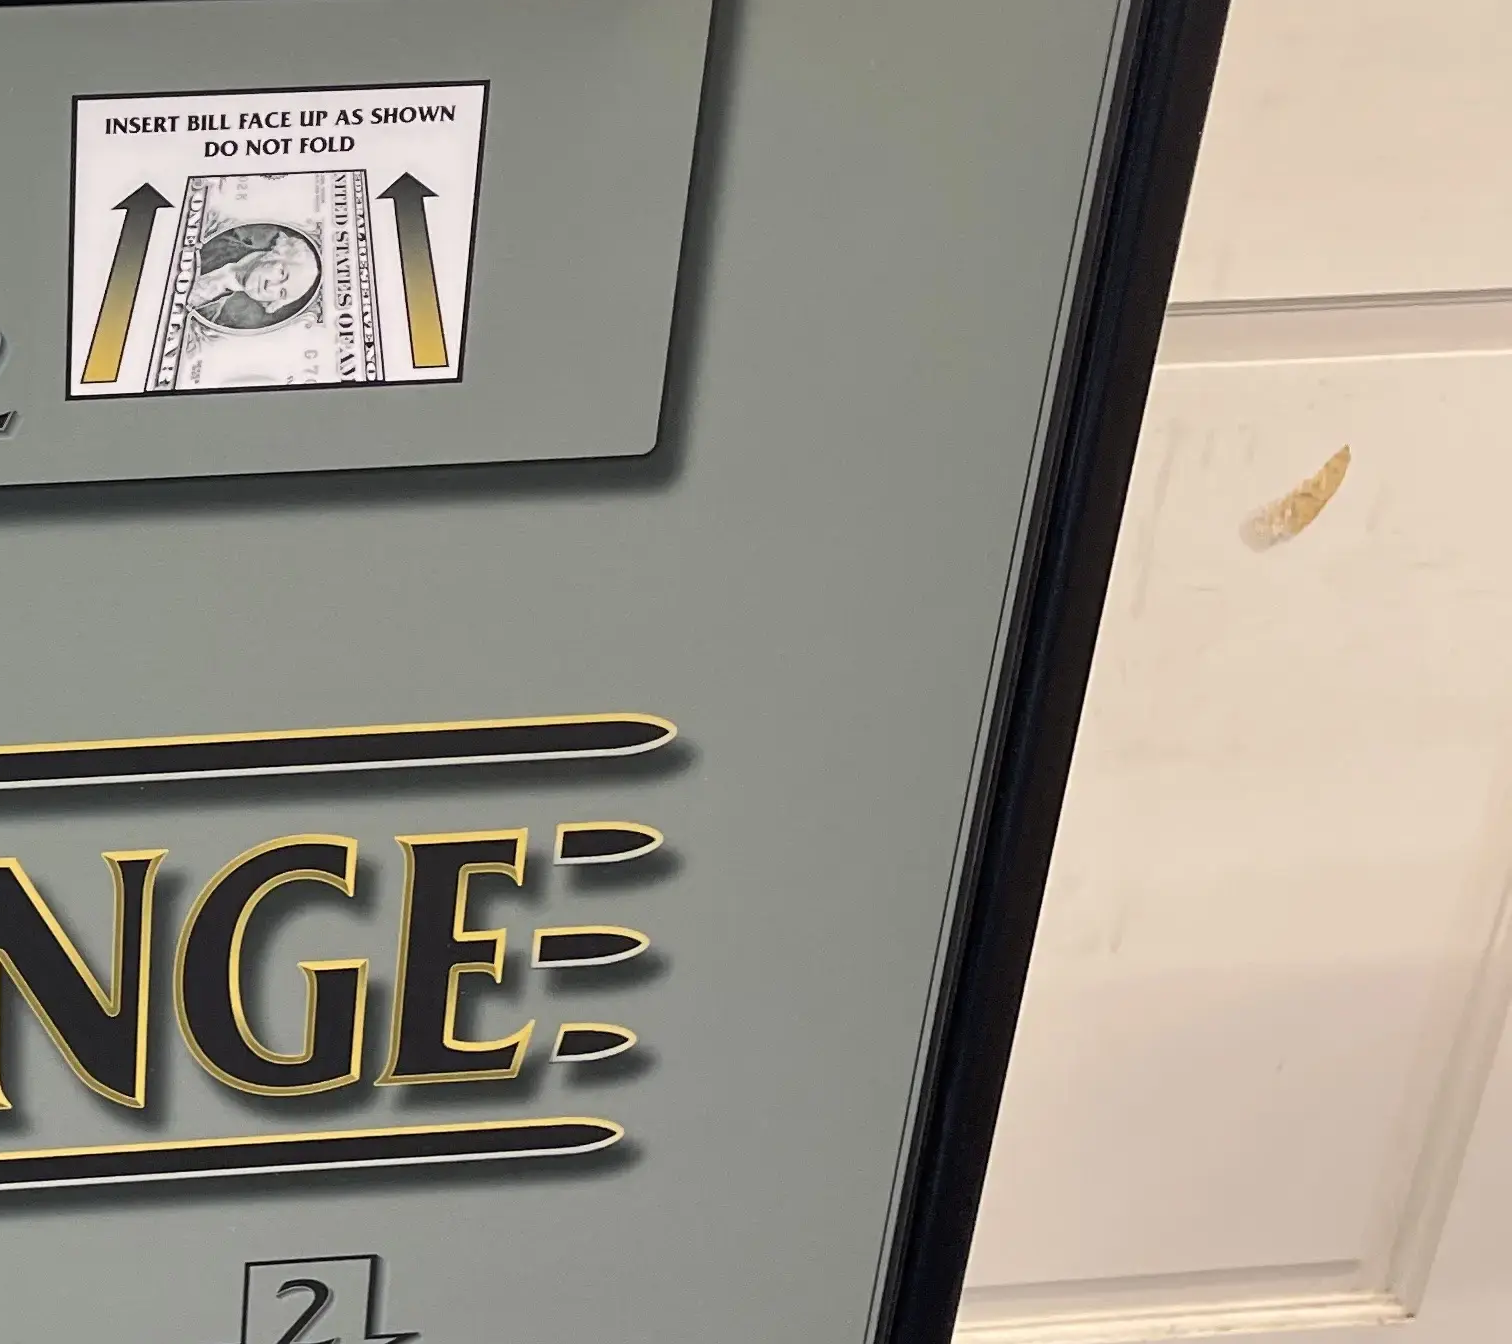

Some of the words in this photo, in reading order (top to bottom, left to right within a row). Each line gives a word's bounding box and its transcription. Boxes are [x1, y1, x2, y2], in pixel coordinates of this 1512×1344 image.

[105, 115, 180, 135] INSERT
[187, 113, 231, 132] BILL
[238, 111, 292, 130] FACE
[299, 110, 328, 127] UP
[335, 108, 364, 126] AS
[370, 104, 456, 125] SHOWN
[204, 140, 239, 158] DO
[245, 138, 293, 156] NOT
[299, 135, 355, 154] FOLD
[183, 192, 205, 246] ONE
[335, 231, 353, 307] STATES
[158, 249, 195, 386] DOLLAR
[338, 313, 355, 344] OF
